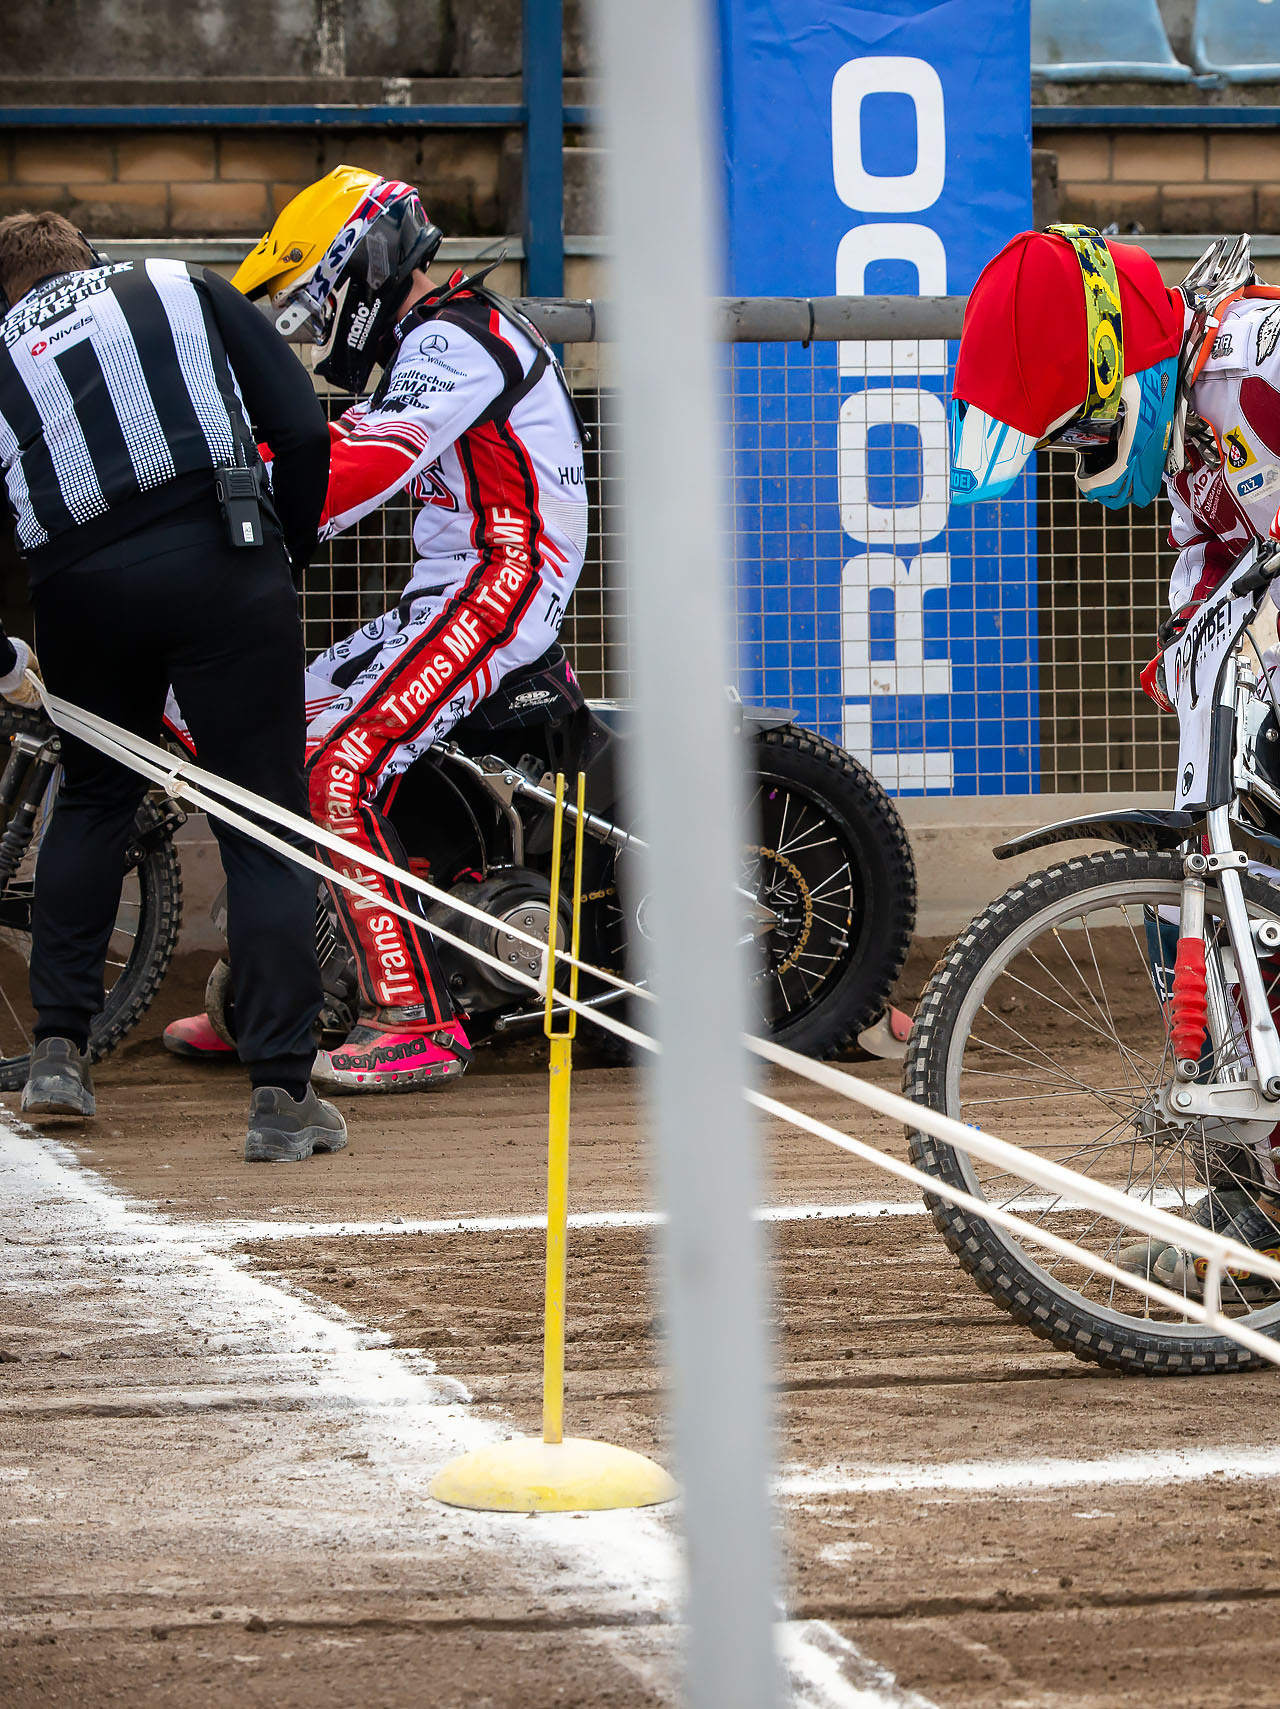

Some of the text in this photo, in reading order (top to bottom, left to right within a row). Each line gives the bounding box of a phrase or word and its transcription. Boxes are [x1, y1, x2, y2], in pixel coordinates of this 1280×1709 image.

[0, 261, 133, 339] IEROWNIK
[4, 278, 108, 350] STARTU
[49, 315, 94, 345] Nivels
[476, 507, 529, 615] Trans MF
[380, 609, 481, 726] Trans MF
[333, 727, 373, 771] MF
[326, 765, 359, 837] Trans
[376, 914, 414, 1002] Trans
[332, 1037, 428, 1072] daytona
